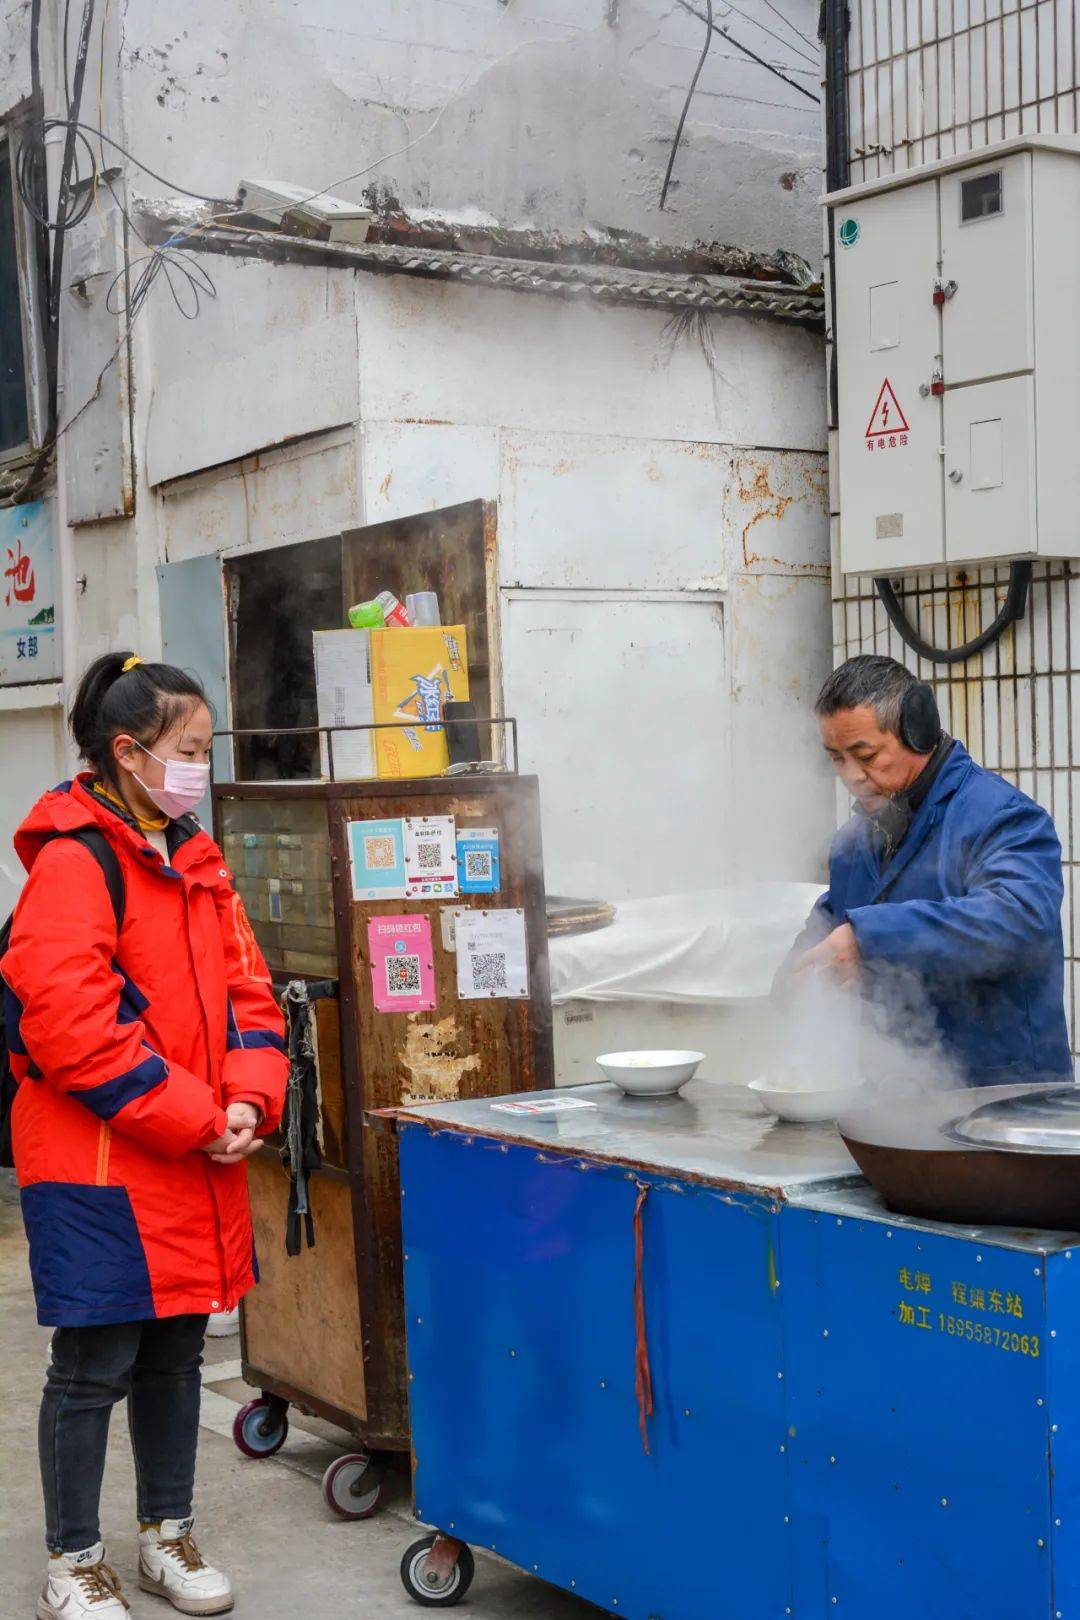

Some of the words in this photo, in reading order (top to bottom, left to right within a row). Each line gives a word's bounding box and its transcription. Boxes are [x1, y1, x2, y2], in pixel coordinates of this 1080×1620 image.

[866, 434, 909, 451] 有电危险
[4, 538, 36, 608] 池
[16, 635, 39, 659] 女部
[898, 1300, 933, 1330] 加工
